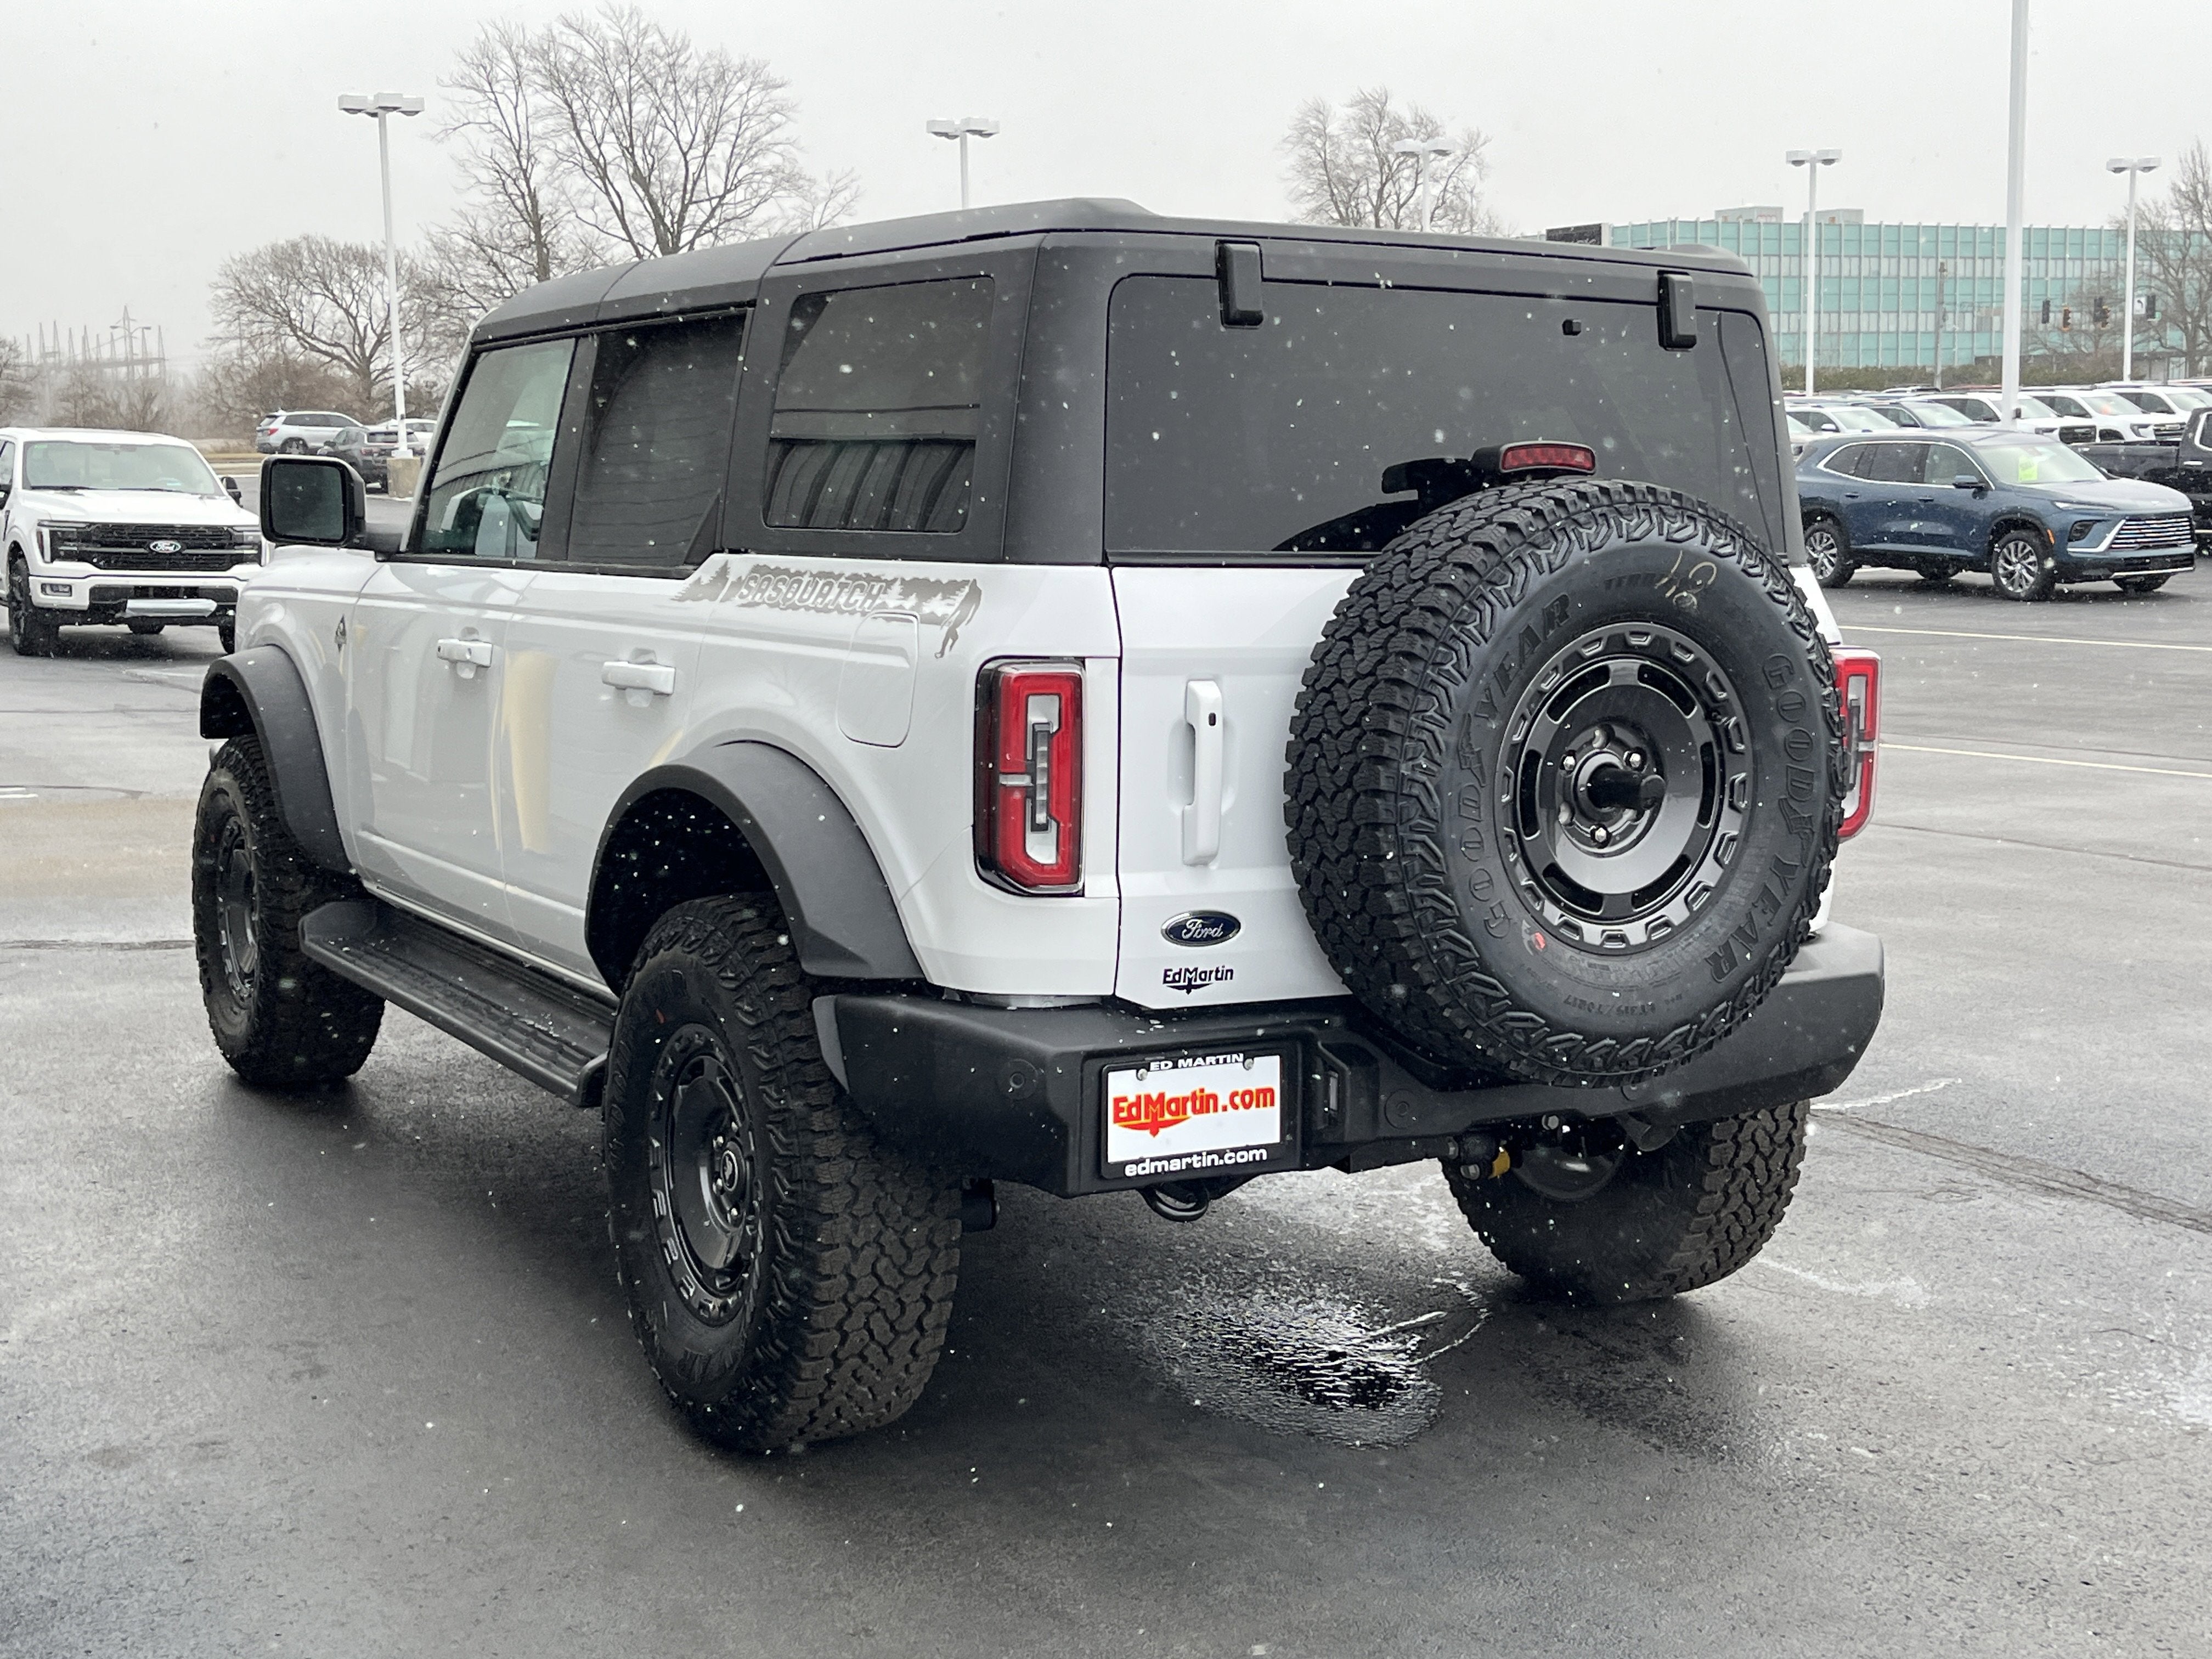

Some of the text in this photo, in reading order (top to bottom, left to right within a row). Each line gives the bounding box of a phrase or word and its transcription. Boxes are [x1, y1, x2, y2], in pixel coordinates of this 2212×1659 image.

[737, 573, 886, 612] SASQUATCH
[1182, 919, 1223, 939] Ford
[1149, 1053, 1244, 1071] ED MARTIN
[1113, 1087, 1276, 1126] EdMartin.com
[1125, 1147, 1268, 1177] edmartin.com
